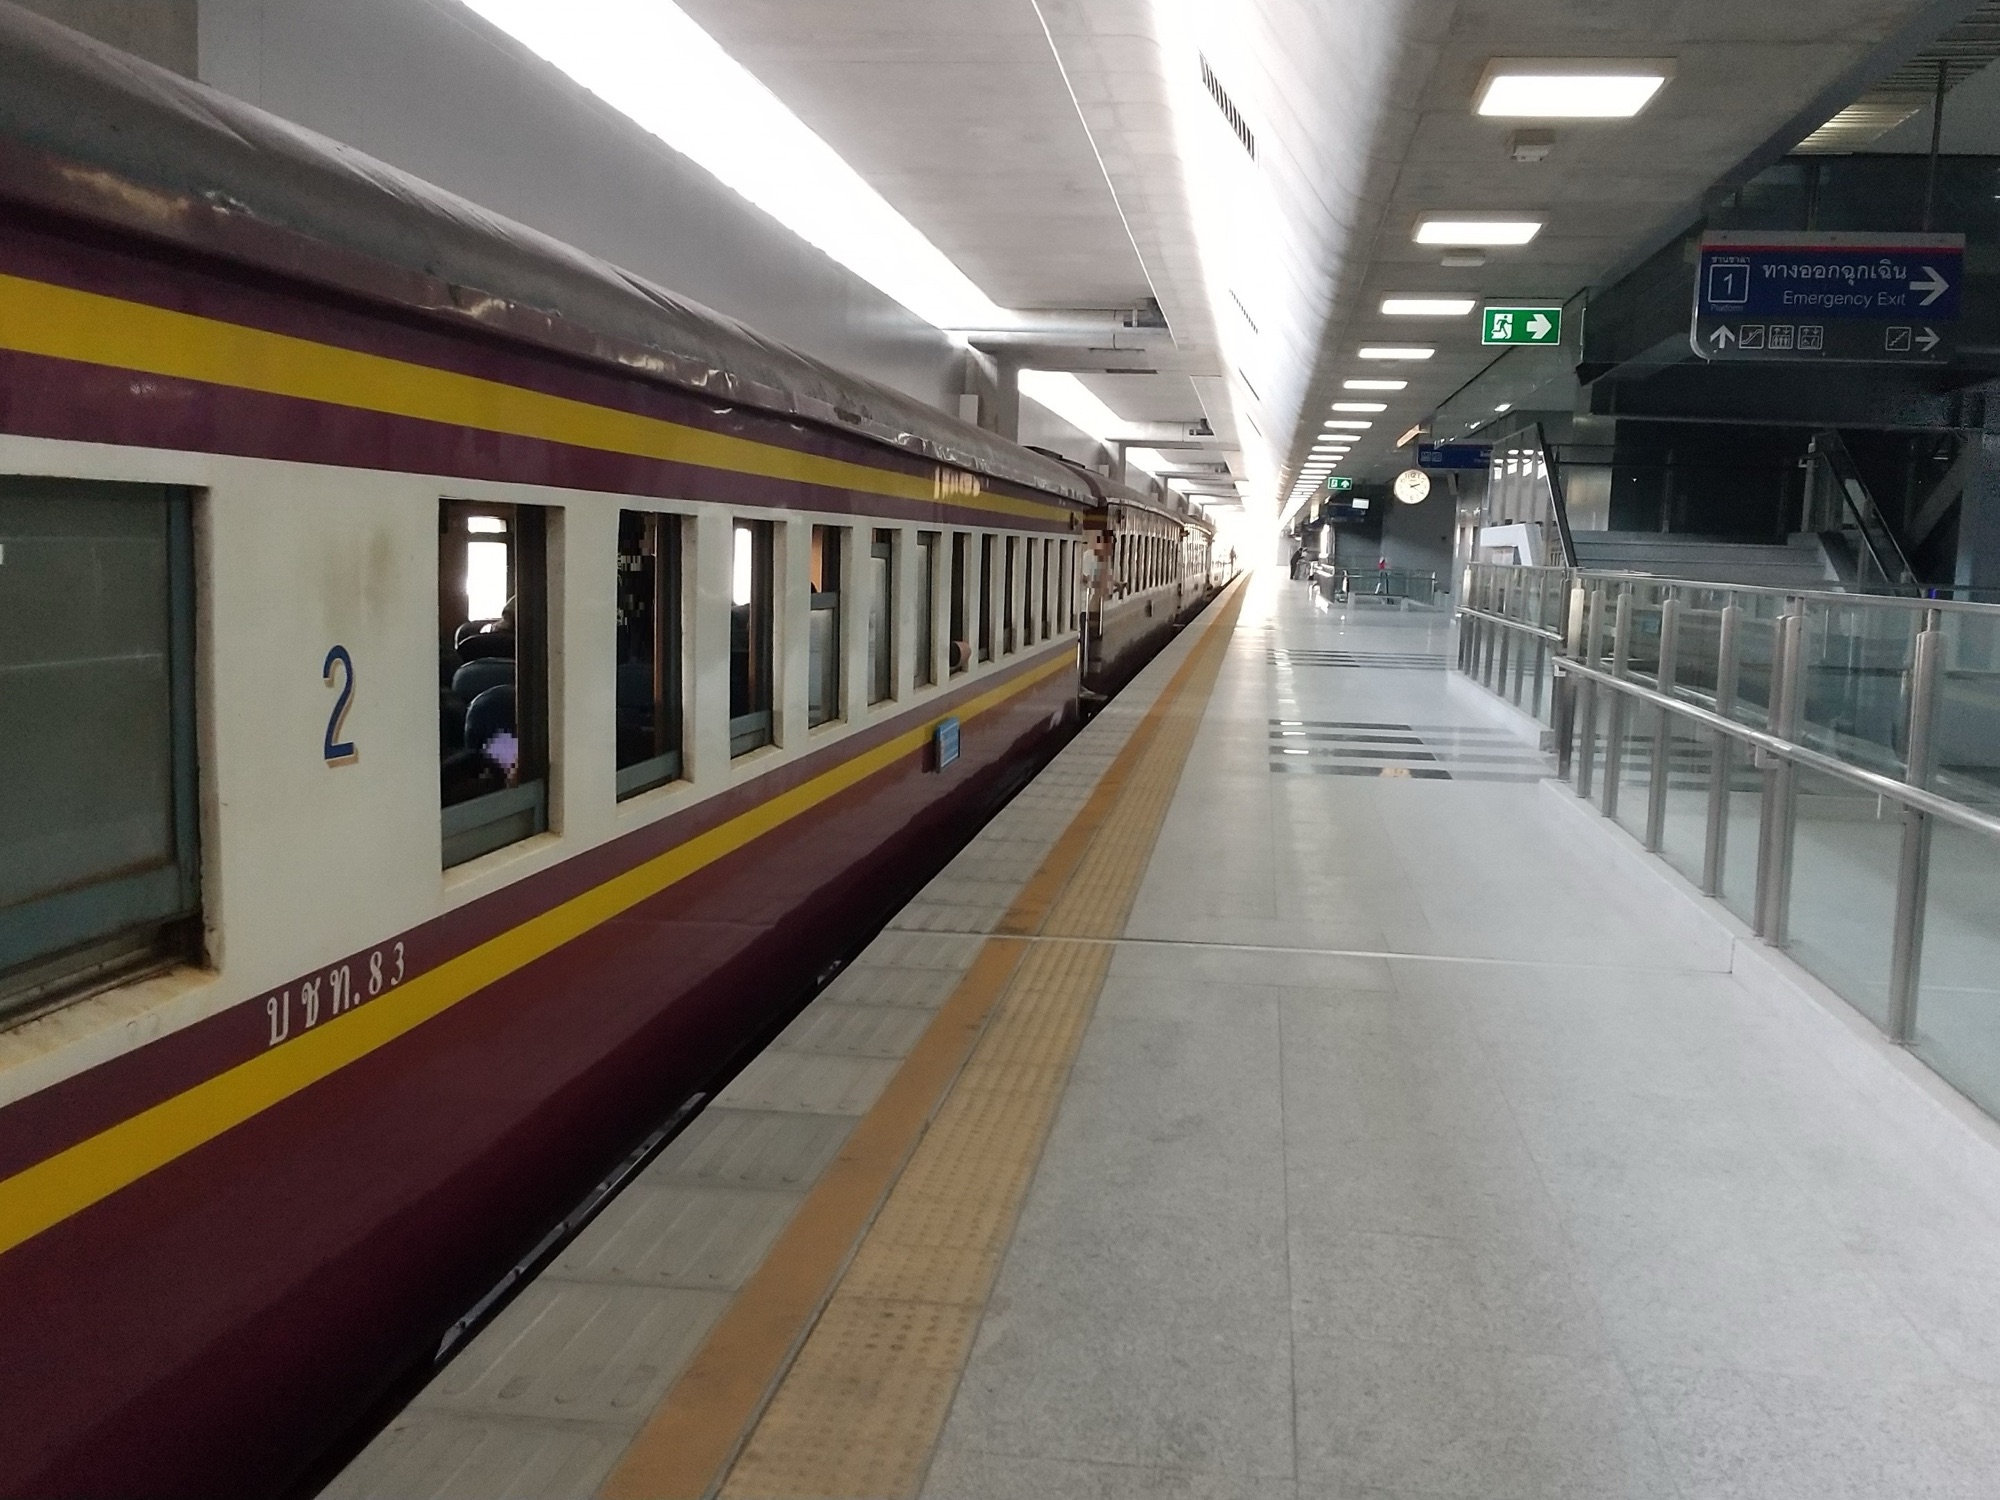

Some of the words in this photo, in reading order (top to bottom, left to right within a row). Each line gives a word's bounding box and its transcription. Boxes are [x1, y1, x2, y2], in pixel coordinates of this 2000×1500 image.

[1723, 273, 1733, 295] 1
[1762, 258, 1907, 286] ทางออกฉุกเฉิน
[1783, 290, 1873, 309] Emergency
[1877, 291, 1906, 306] Exit
[323, 645, 358, 767] 2
